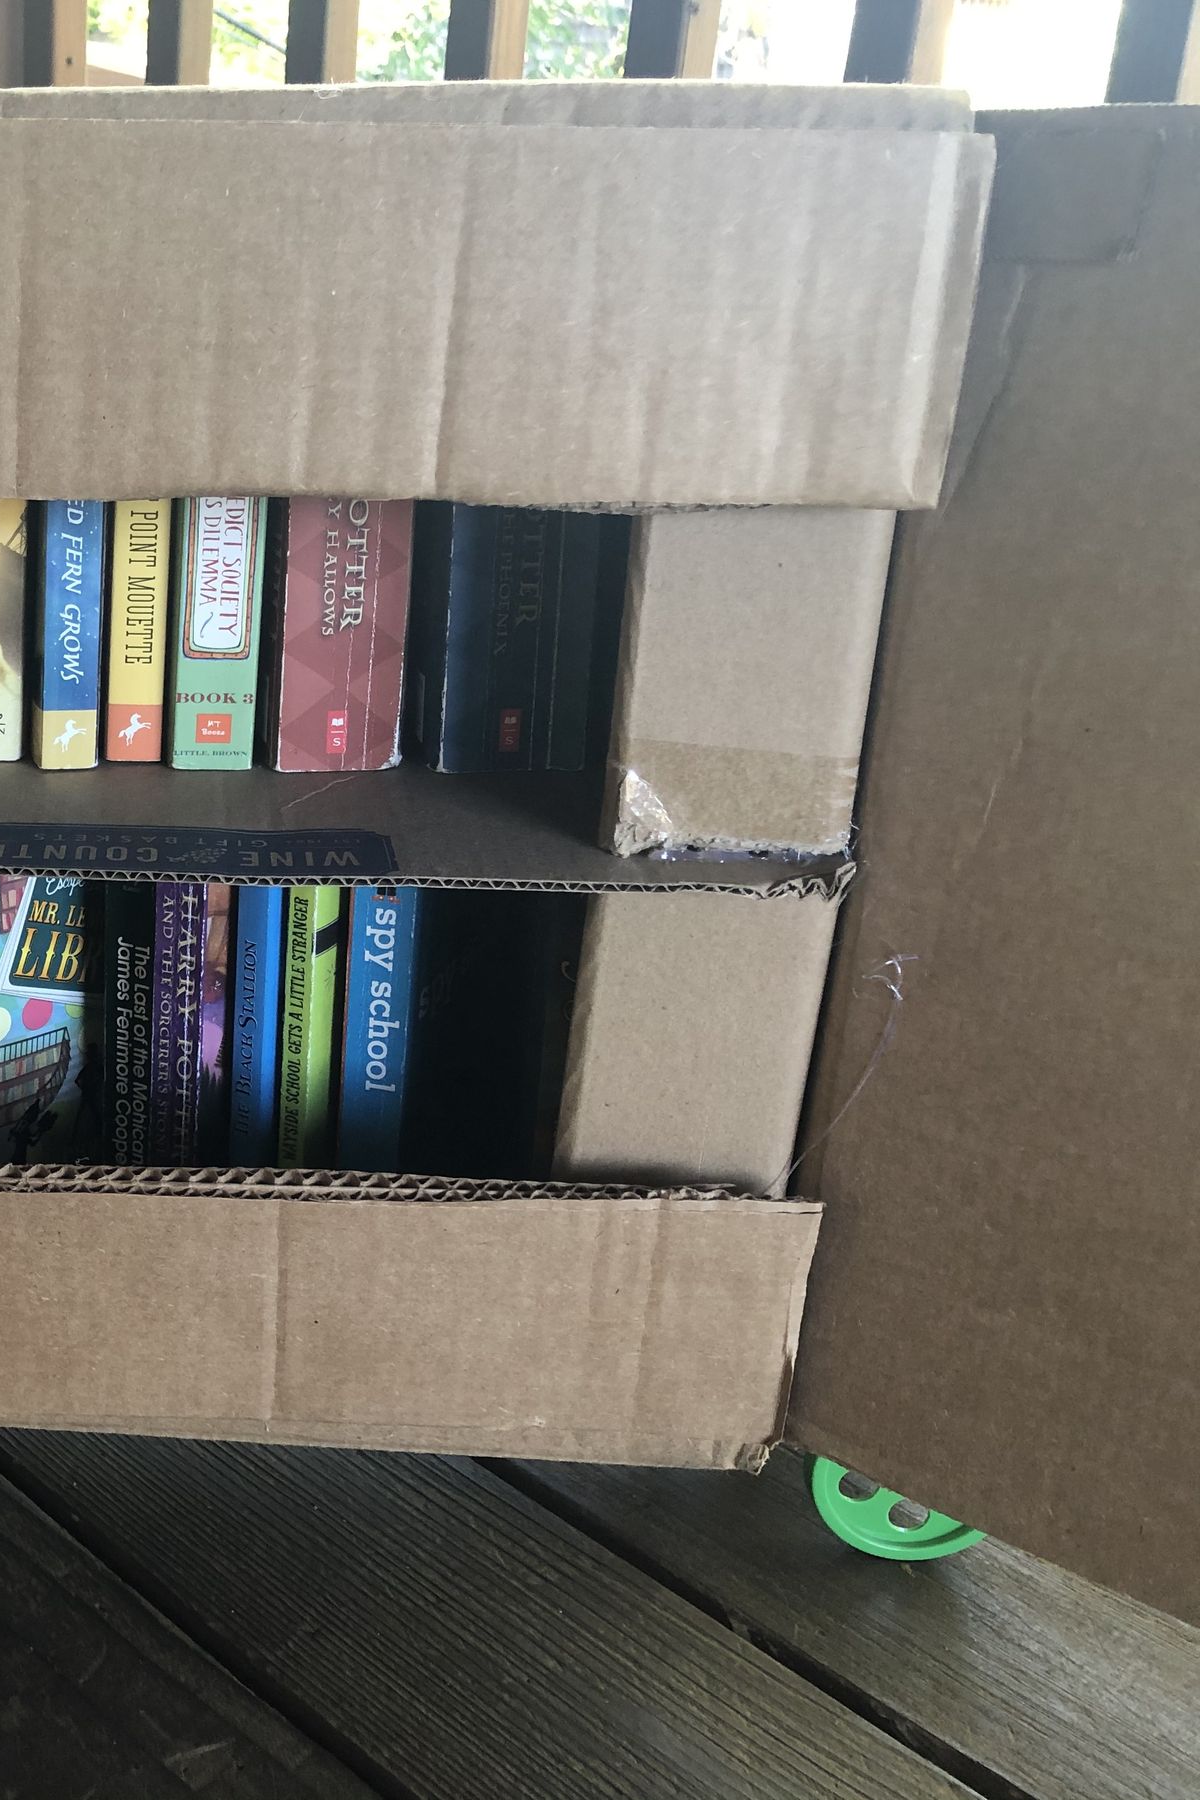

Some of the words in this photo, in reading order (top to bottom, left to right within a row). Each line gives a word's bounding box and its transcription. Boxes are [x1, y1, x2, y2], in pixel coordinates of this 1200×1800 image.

[60, 532, 83, 594] FERN
[128, 510, 159, 568] POINT
[199, 516, 221, 606] DILEMMA
[218, 556, 242, 636] SOCIETY
[321, 529, 339, 636] HALLOWS
[59, 603, 84, 684] GROWS
[125, 576, 155, 665] MOUETTE
[176, 692, 237, 704] BOOK
[242, 693, 254, 704] 3
[240, 850, 360, 867] WINE
[28, 900, 60, 925] MR.
[162, 895, 175, 939] AND
[292, 897, 309, 964] STRANGER
[364, 907, 397, 971] spy
[13, 927, 87, 984] LIB
[116, 936, 134, 1001] James
[133, 946, 150, 981] The
[160, 946, 174, 986] THE
[176, 892, 200, 1026] HARRY
[238, 939, 258, 1030] STALLION
[133, 983, 149, 1021] Last
[290, 965, 305, 1008] LITTLE
[290, 1009, 304, 1022] A
[114, 1007, 132, 1094] Fenimore
[133, 1024, 149, 1046] of
[133, 1048, 149, 1079] the
[157, 991, 173, 1095] SORCERER'S
[235, 1032, 254, 1095] BLACK
[288, 1023, 303, 1056] GETS
[364, 981, 399, 1093] school
[286, 1058, 301, 1104] SCHOOL
[282, 1102, 298, 1161] WAYSIDE
